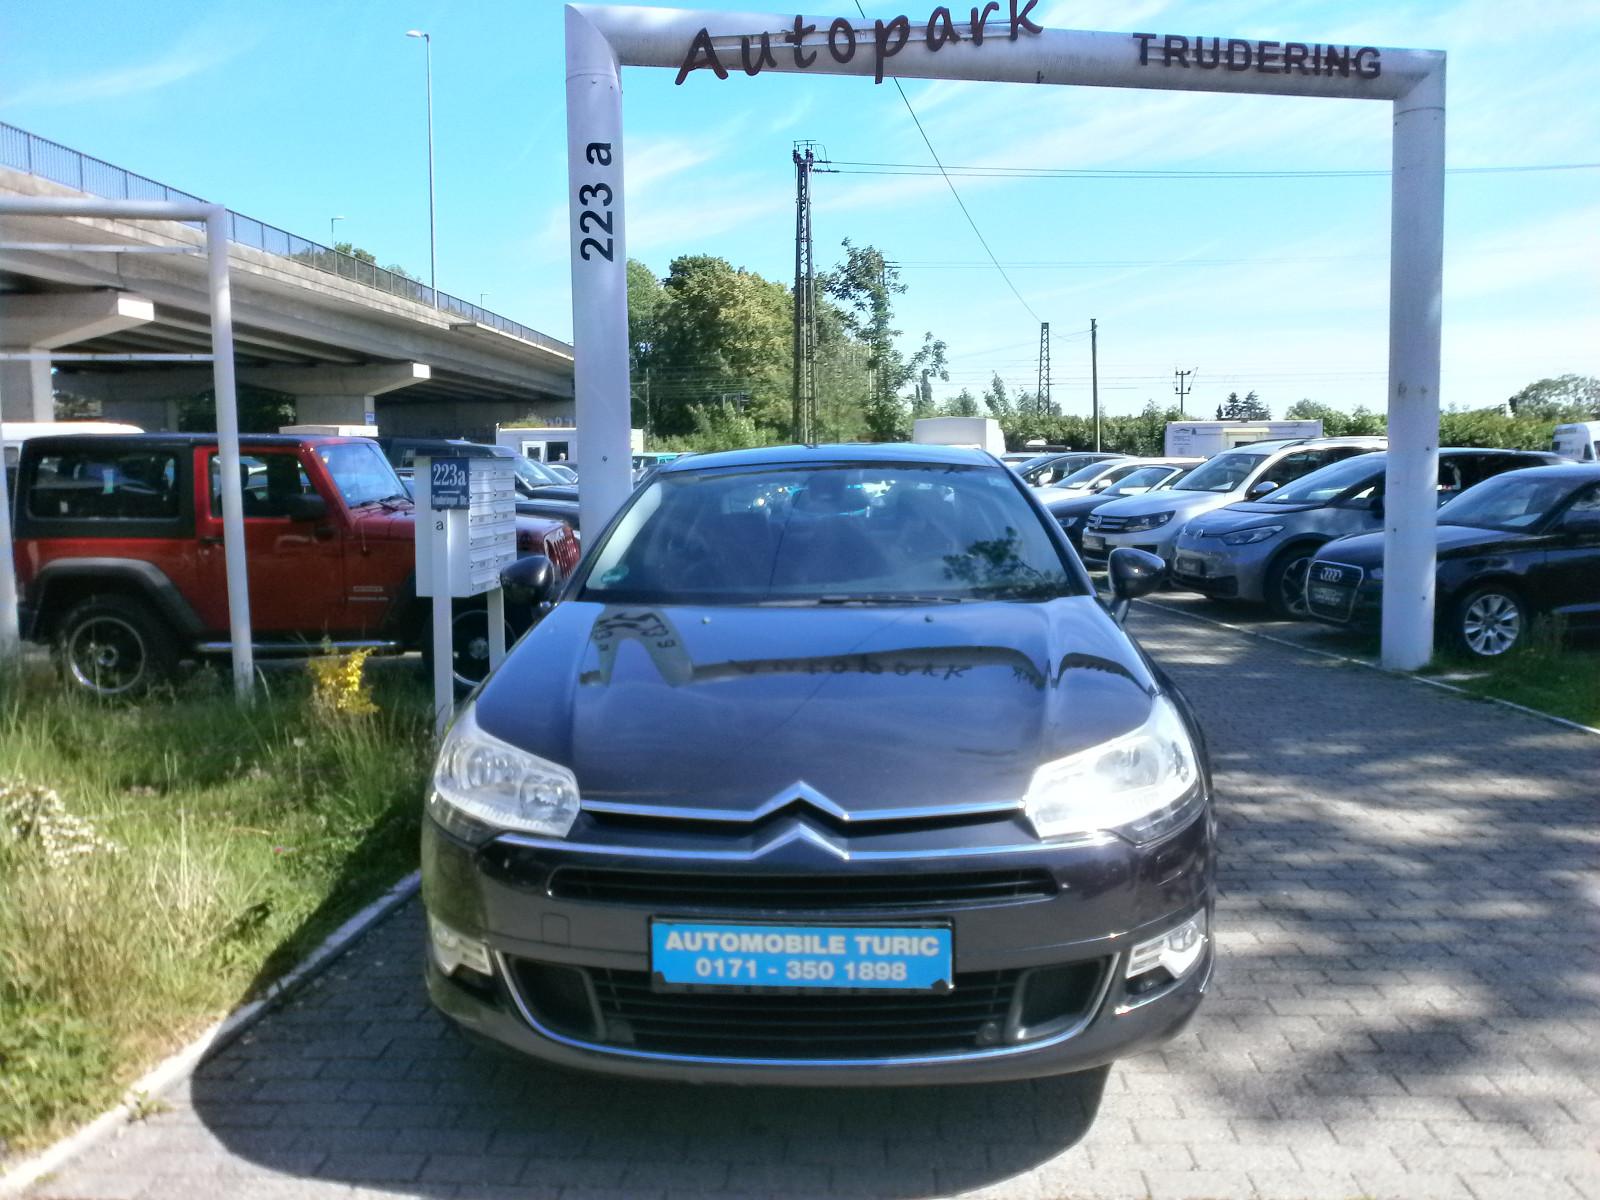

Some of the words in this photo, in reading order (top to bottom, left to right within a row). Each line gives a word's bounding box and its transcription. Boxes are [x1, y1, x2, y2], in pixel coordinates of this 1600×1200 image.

[675, 0, 1043, 85] Autopark
[1133, 32, 1382, 79] TRUDERING
[586, 142, 612, 166] a
[579, 183, 613, 262] 223
[433, 463, 467, 486] 223a
[436, 520, 444, 531] a
[665, 931, 846, 954] AUTOMOBILE
[855, 935, 940, 957] TURIC
[696, 957, 757, 979] 0171
[786, 960, 835, 981] 350
[845, 961, 908, 982] 1898
